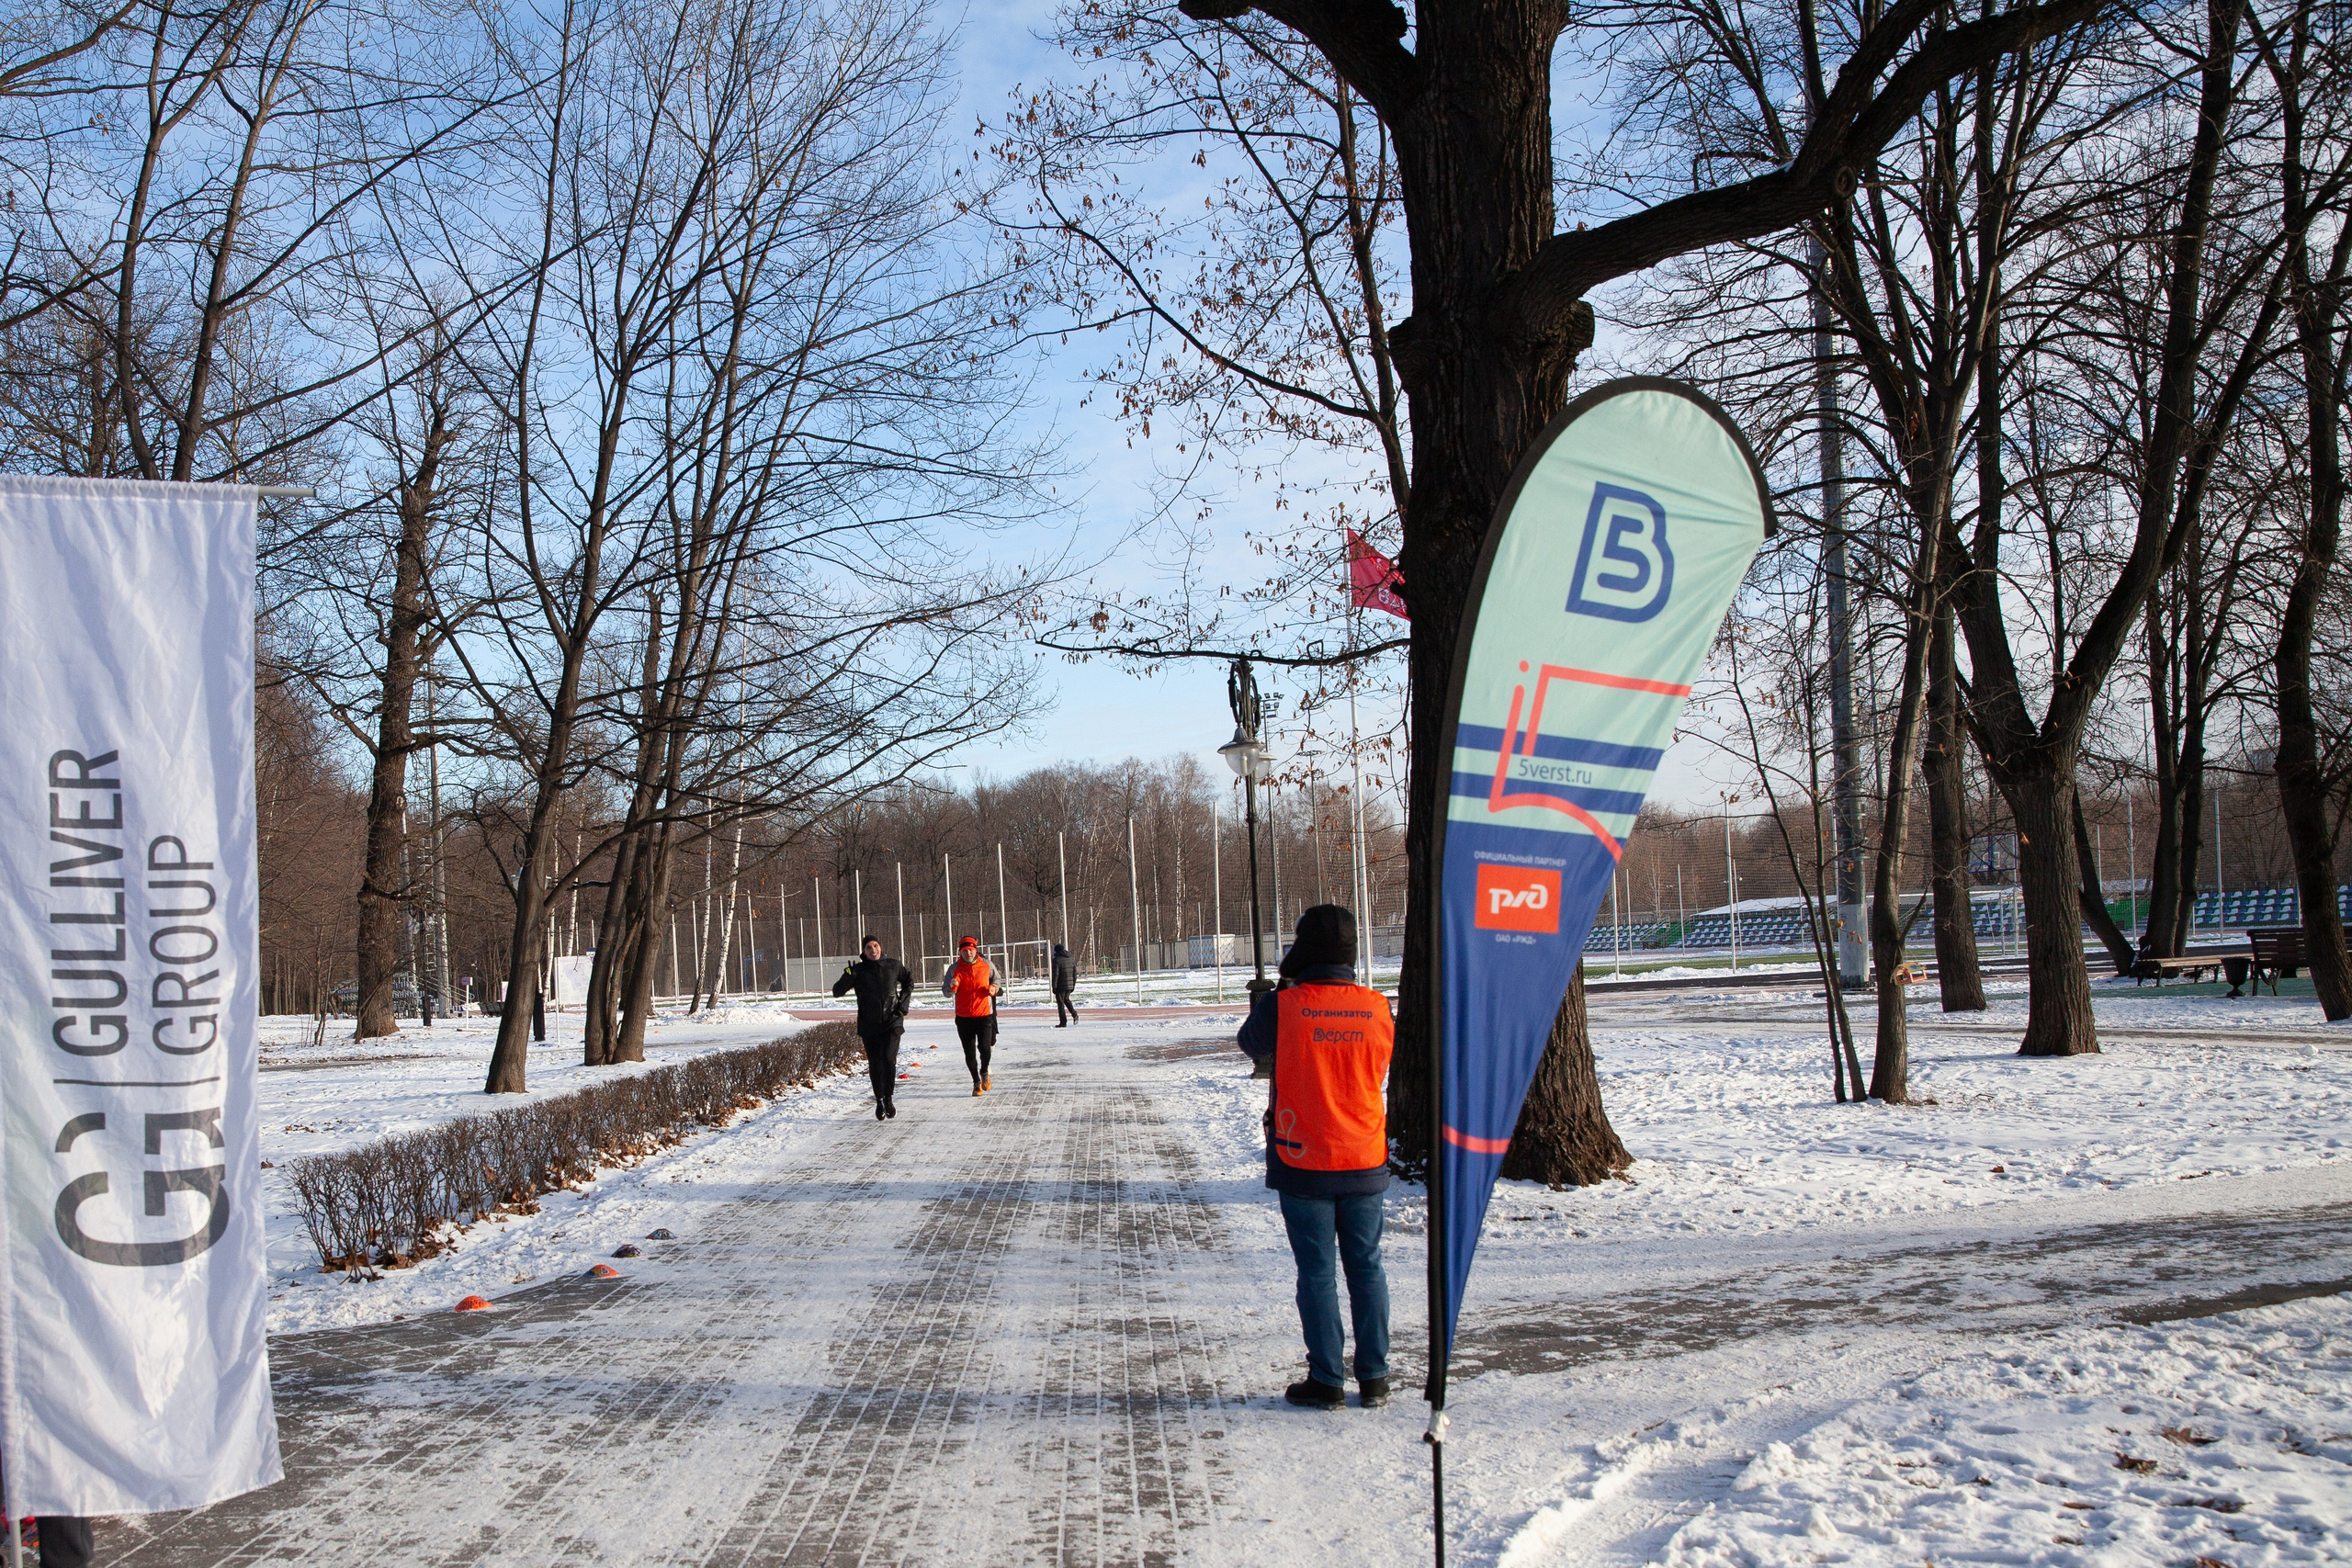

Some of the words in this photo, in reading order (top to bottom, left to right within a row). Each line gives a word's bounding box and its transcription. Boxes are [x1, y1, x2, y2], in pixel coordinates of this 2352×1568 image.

[1518, 759, 1592, 784] 5verst.ru
[49, 749, 130, 1058] GULLIVER
[147, 834, 221, 1056] GROUP
[1301, 1007, 1374, 1021] Организатор
